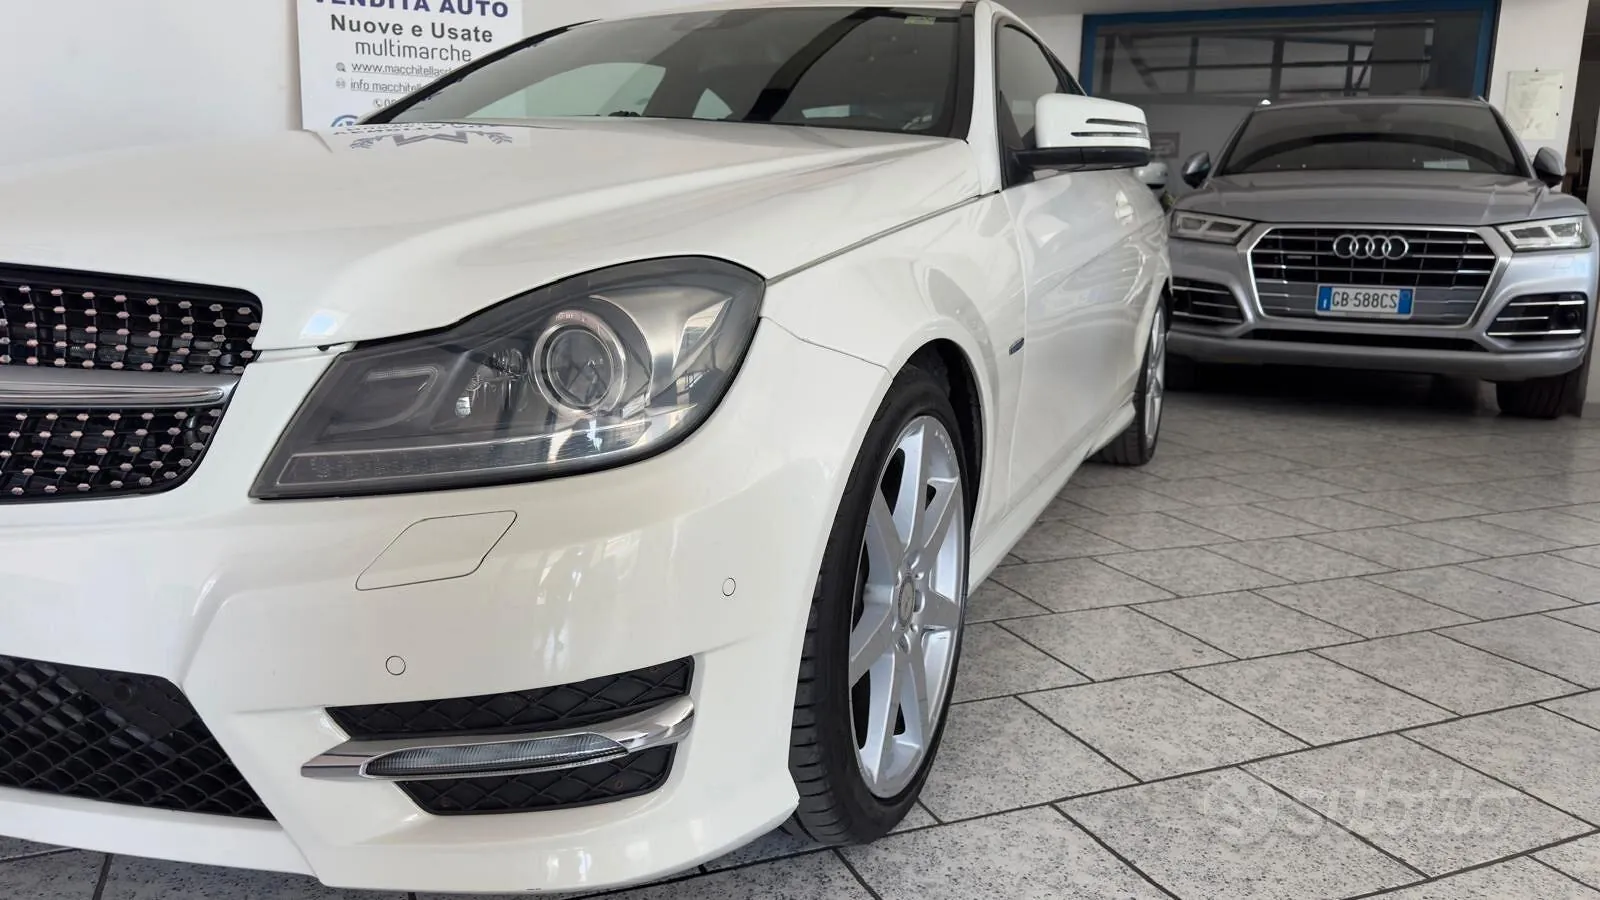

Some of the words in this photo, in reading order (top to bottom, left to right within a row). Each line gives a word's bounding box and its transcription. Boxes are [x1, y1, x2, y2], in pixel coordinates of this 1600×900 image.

[439, 0, 509, 18] AUTO
[330, 14, 403, 36] Nuove
[411, 24, 423, 37] e
[431, 22, 493, 43] Usate
[355, 39, 472, 62] multimarche
